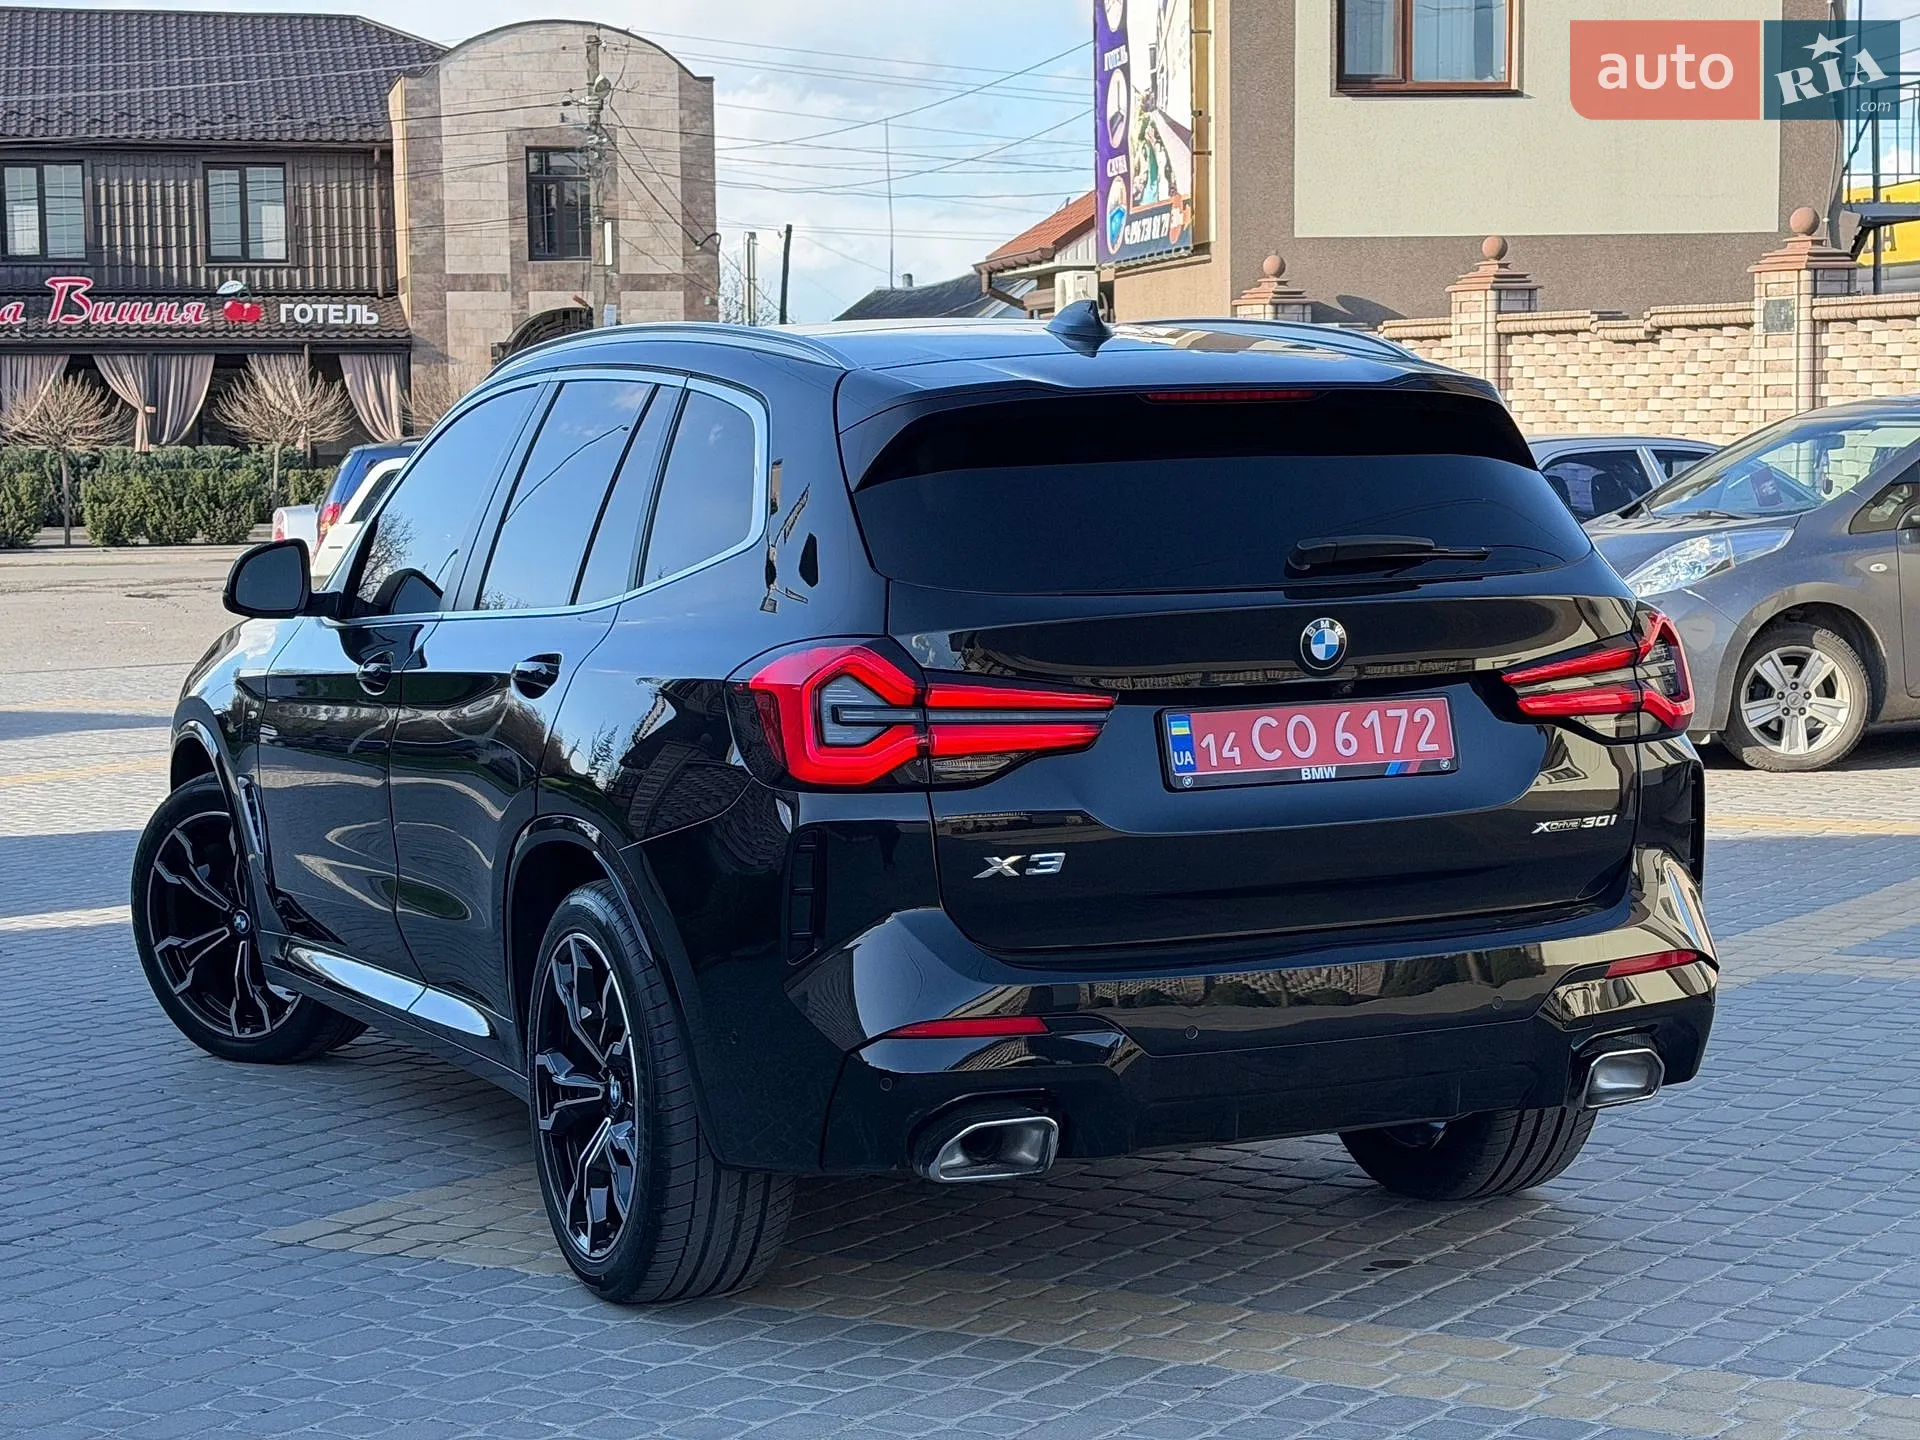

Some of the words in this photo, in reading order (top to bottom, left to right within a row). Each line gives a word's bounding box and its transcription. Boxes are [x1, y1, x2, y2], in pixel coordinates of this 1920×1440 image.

[45, 276, 208, 325] Вишня
[279, 303, 380, 325] ГОТЕЛЬ
[1333, 707, 1440, 757] 6172
[1174, 751, 1195, 766] UA
[1301, 766, 1337, 780] BMW
[972, 852, 1066, 879] X3
